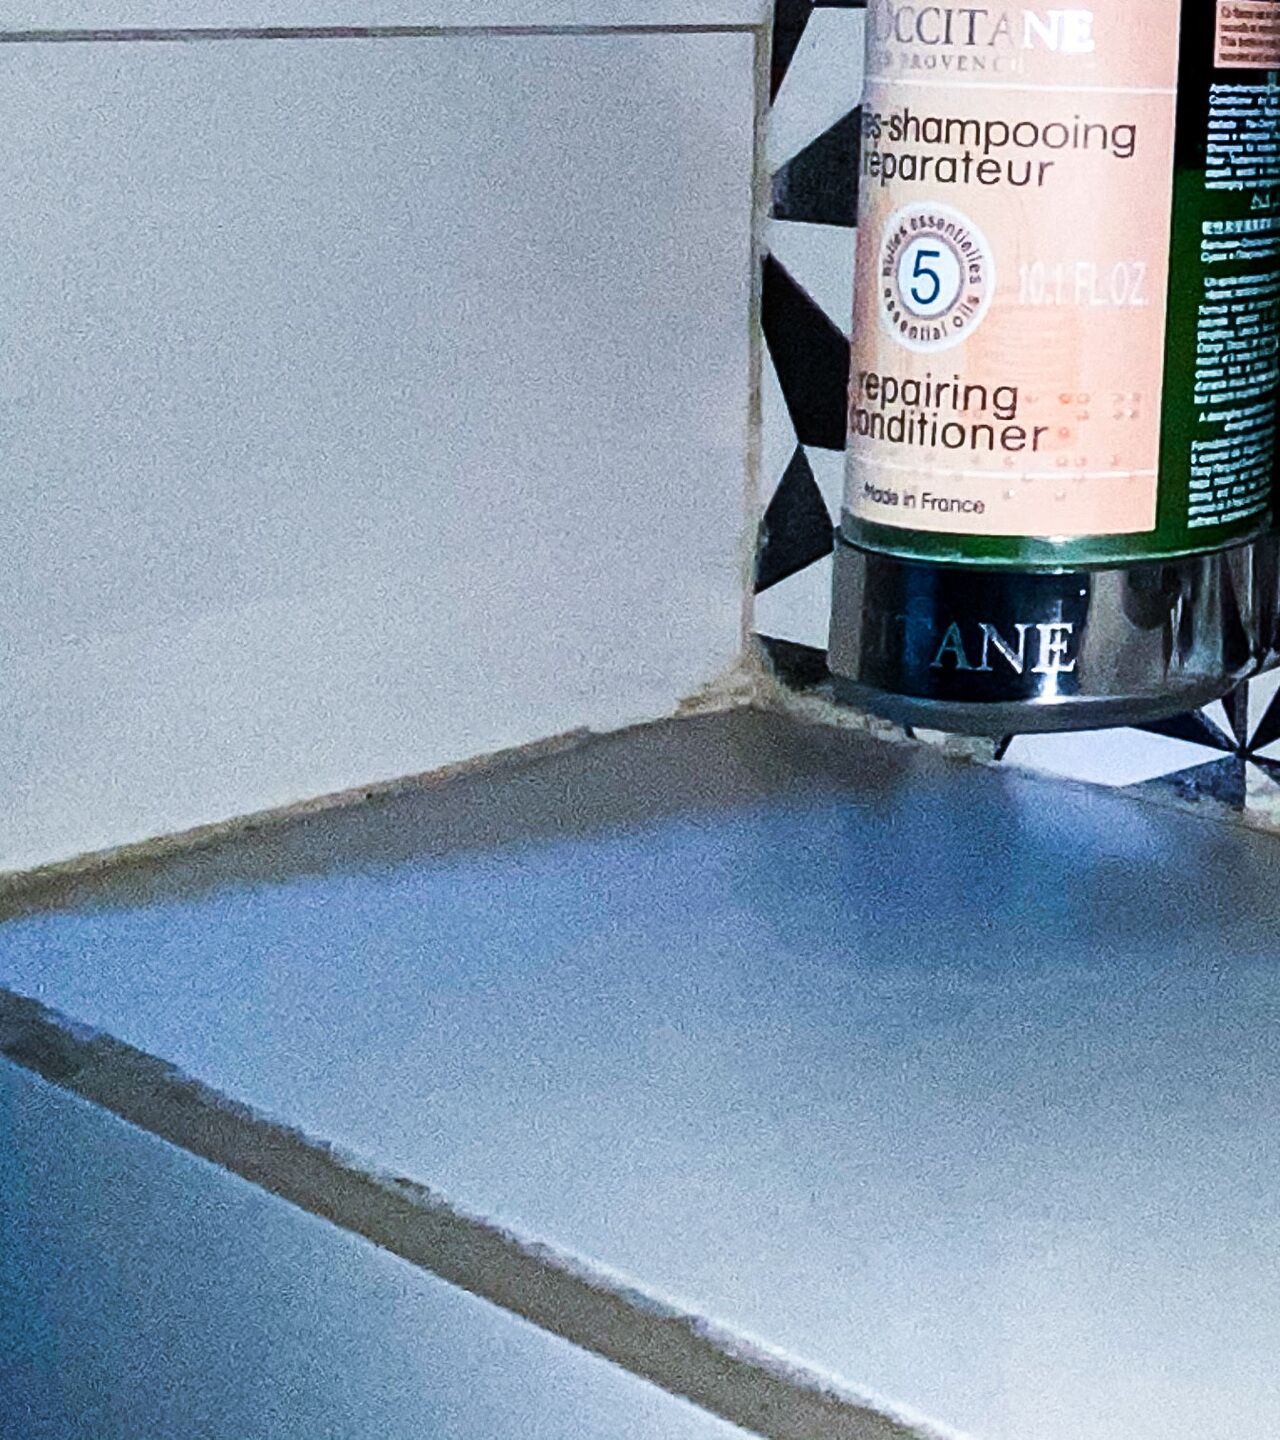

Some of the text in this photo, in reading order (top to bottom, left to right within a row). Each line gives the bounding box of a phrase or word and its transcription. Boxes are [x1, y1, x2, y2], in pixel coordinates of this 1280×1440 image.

[911, 250, 940, 305] 5
[904, 489, 916, 509] in
[922, 492, 985, 514] France
